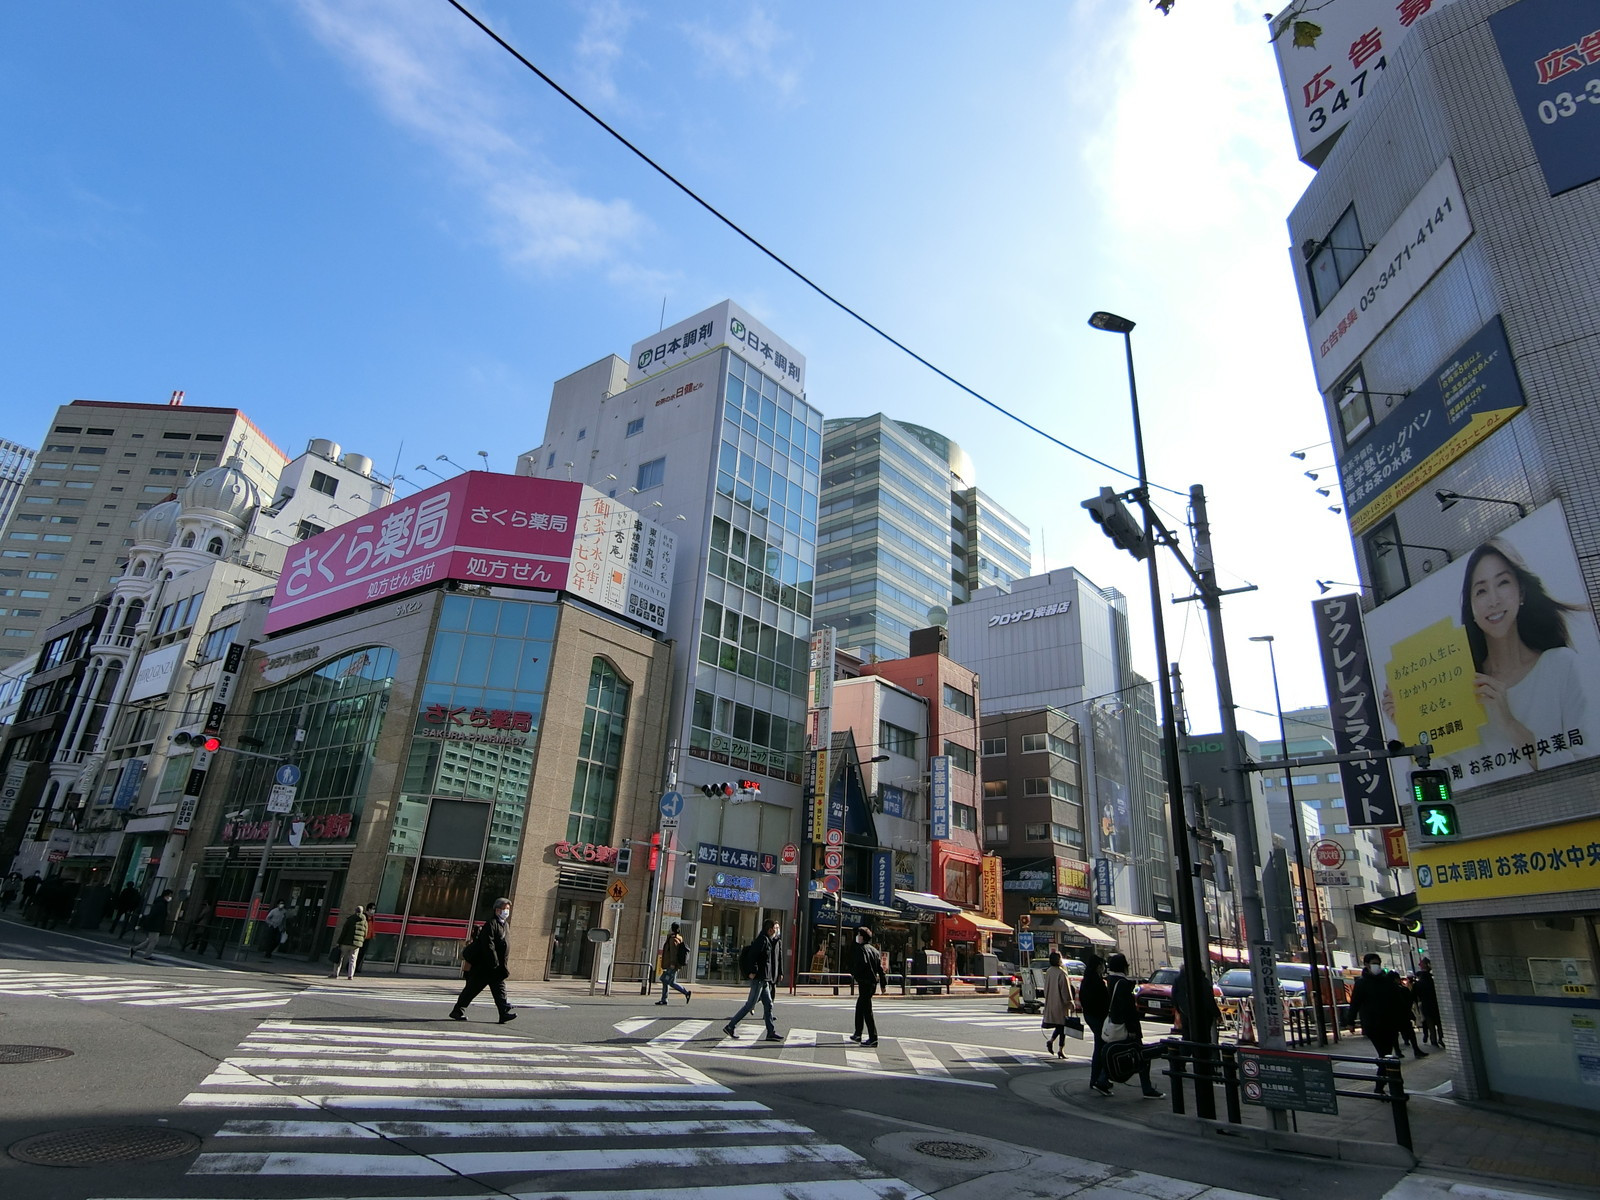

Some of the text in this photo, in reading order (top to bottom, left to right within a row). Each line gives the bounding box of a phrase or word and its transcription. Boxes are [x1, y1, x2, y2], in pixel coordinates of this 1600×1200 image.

[1308, 55, 1387, 133] 3471
[1320, 197, 1452, 358] 広告募集 03-3471-4141
[653, 320, 714, 362] 日本調剤
[748, 330, 801, 383] 日本調剤
[1344, 409, 1432, 492] 進学塾ビッグバン
[1348, 447, 1412, 507] 東京お茶の水校
[471, 506, 568, 533] さくら薬局
[286, 491, 451, 597] さくら薬局
[587, 497, 610, 595] 御茶ノ水の街と
[367, 561, 435, 598] 処方せん受付
[466, 558, 552, 583] 処方せん
[633, 579, 666, 599] PRONTO
[988, 601, 1072, 628] クロサワ楽器店
[1394, 644, 1462, 681] あなたの人生に、
[1399, 666, 1463, 699] 「かかりつけ」の
[424, 704, 532, 733] さくら薬局
[1418, 697, 1452, 717] 安心を。
[422, 727, 466, 742] SAKURA
[1429, 719, 1464, 741] 日本調剤
[722, 742, 767, 762] ユアクリニック
[1468, 729, 1584, 776] お茶の水中央薬局
[933, 757, 947, 836] 管楽器専門店
[289, 813, 353, 839] くら薬局
[829, 833, 839, 841] 40
[698, 845, 758, 868] 処方せん受付
[1318, 850, 1339, 860] 消火栓
[1436, 858, 1493, 884] 日本調剤
[1495, 841, 1600, 876] お茶の水中央
